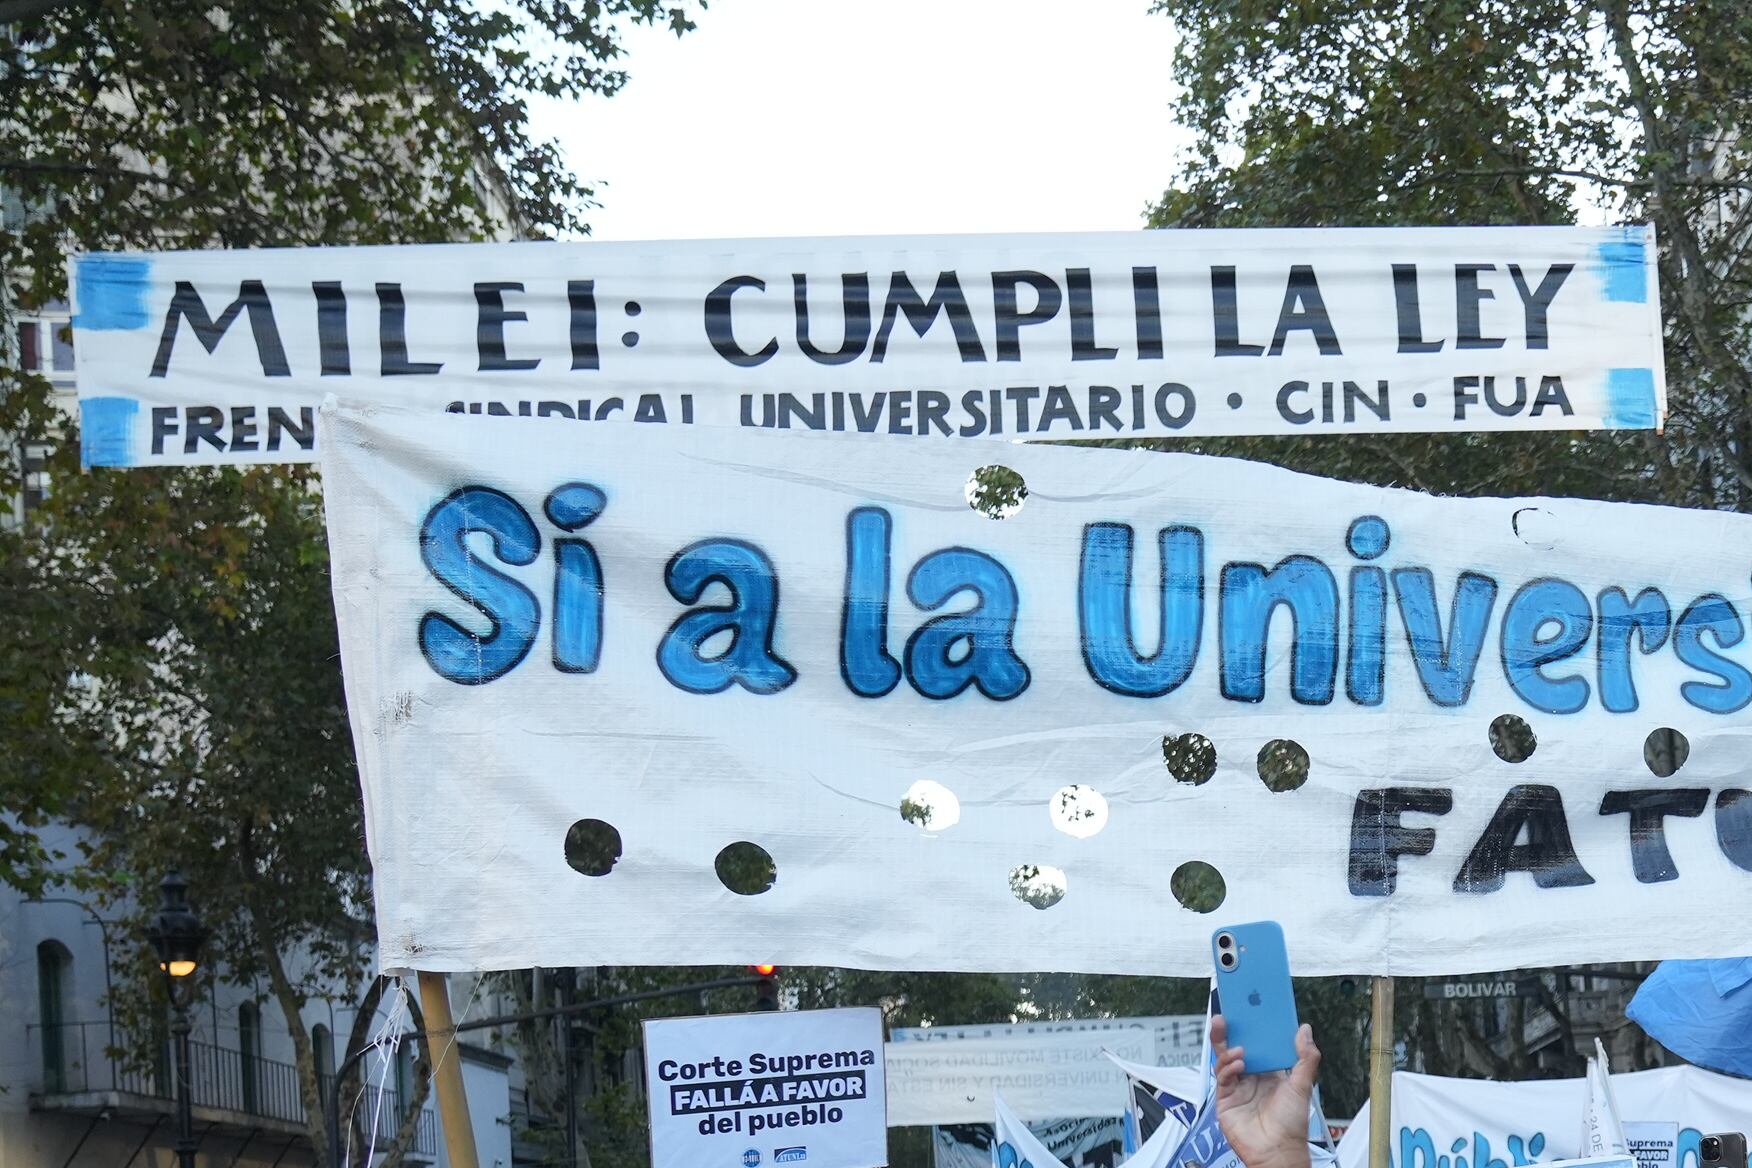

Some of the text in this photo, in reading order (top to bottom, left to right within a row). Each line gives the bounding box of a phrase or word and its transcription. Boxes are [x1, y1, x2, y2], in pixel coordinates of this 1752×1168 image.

[149, 262, 1576, 378] MILEI: CUMPLI LA LEY
[739, 382, 1197, 437] UNIVERSITARIO
[1276, 379, 1390, 425] CIN
[1454, 375, 1575, 421] FUA
[418, 481, 607, 686] Si
[654, 536, 798, 695] a
[839, 505, 1032, 703] la
[1443, 982, 1517, 998] BOLIVAR
[658, 1049, 875, 1081] Corte Suprema
[674, 1076, 864, 1111] FALLÁ A FAVOR
[698, 1104, 844, 1136] del pueblo
